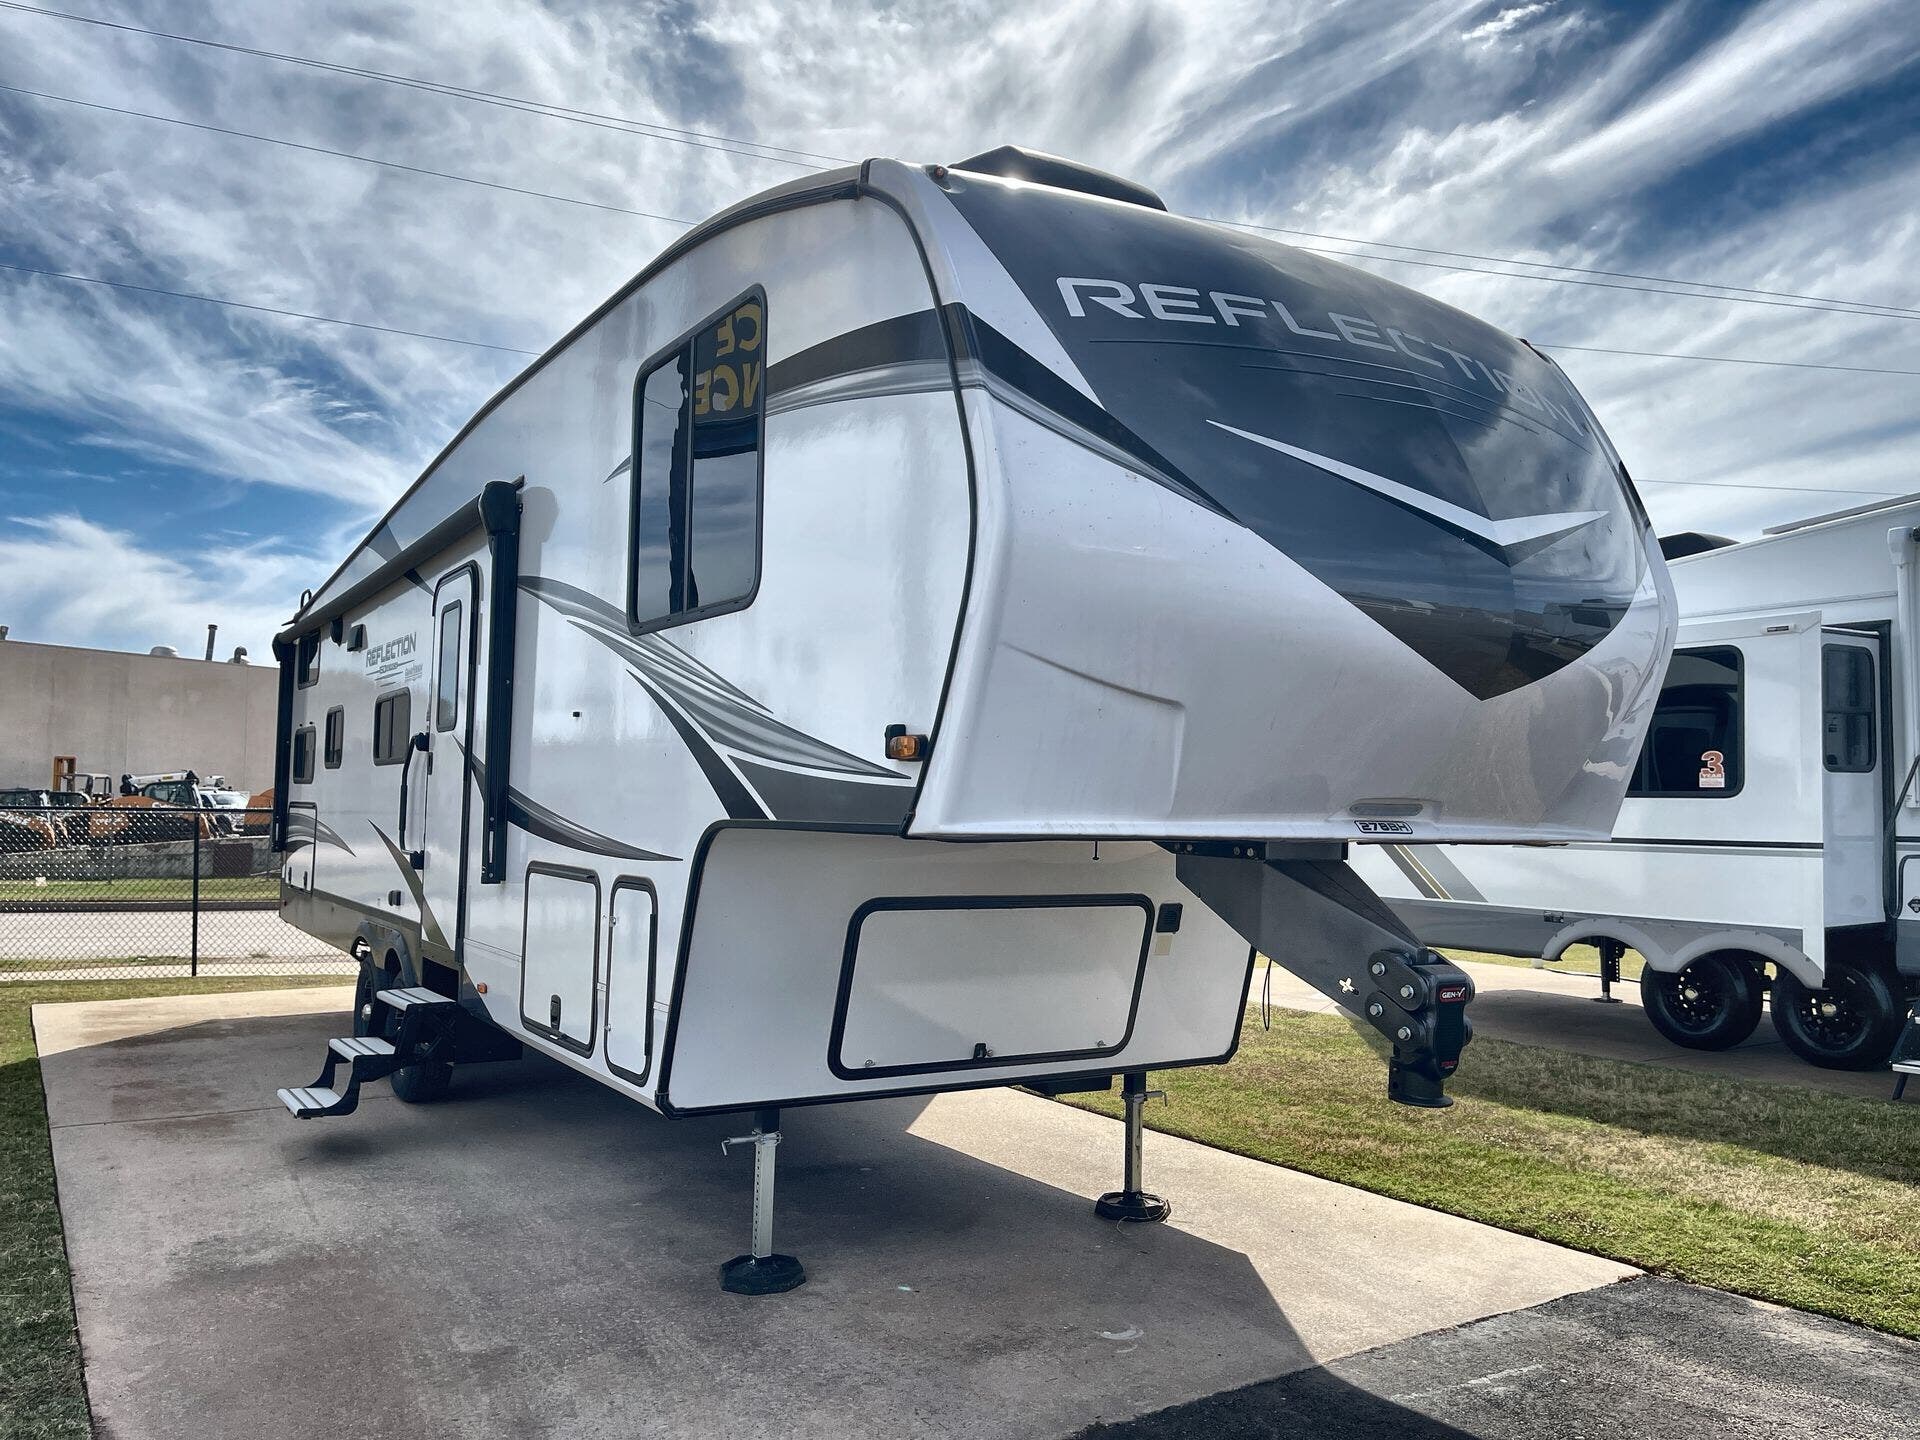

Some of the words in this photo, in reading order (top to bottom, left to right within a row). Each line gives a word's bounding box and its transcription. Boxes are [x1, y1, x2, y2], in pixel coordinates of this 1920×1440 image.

[1056, 276, 1585, 437] REFLECTION
[366, 632, 417, 668] REFLECTION
[1701, 750, 1724, 774] 3
[1442, 987, 1465, 999] GEN-Y
